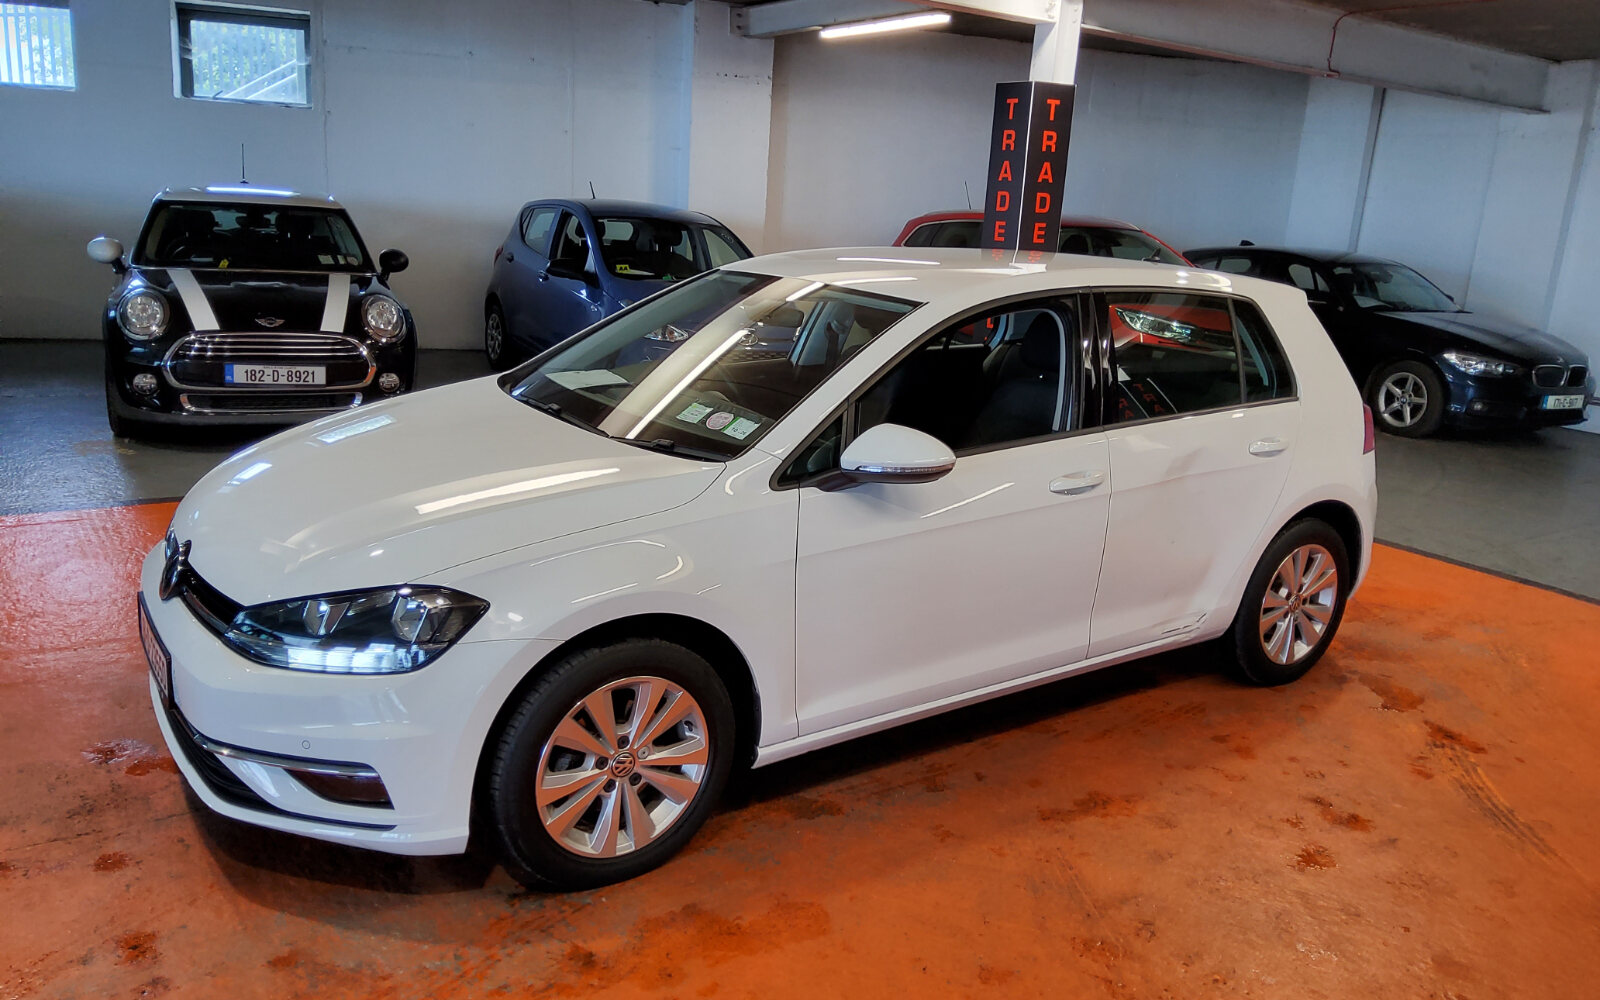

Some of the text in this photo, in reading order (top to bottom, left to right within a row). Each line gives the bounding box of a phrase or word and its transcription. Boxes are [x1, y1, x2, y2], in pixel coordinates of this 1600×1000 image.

[993, 97, 1019, 242] TRADE
[1032, 98, 1061, 244] TRADE
[244, 369, 315, 383] 182-D-8921
